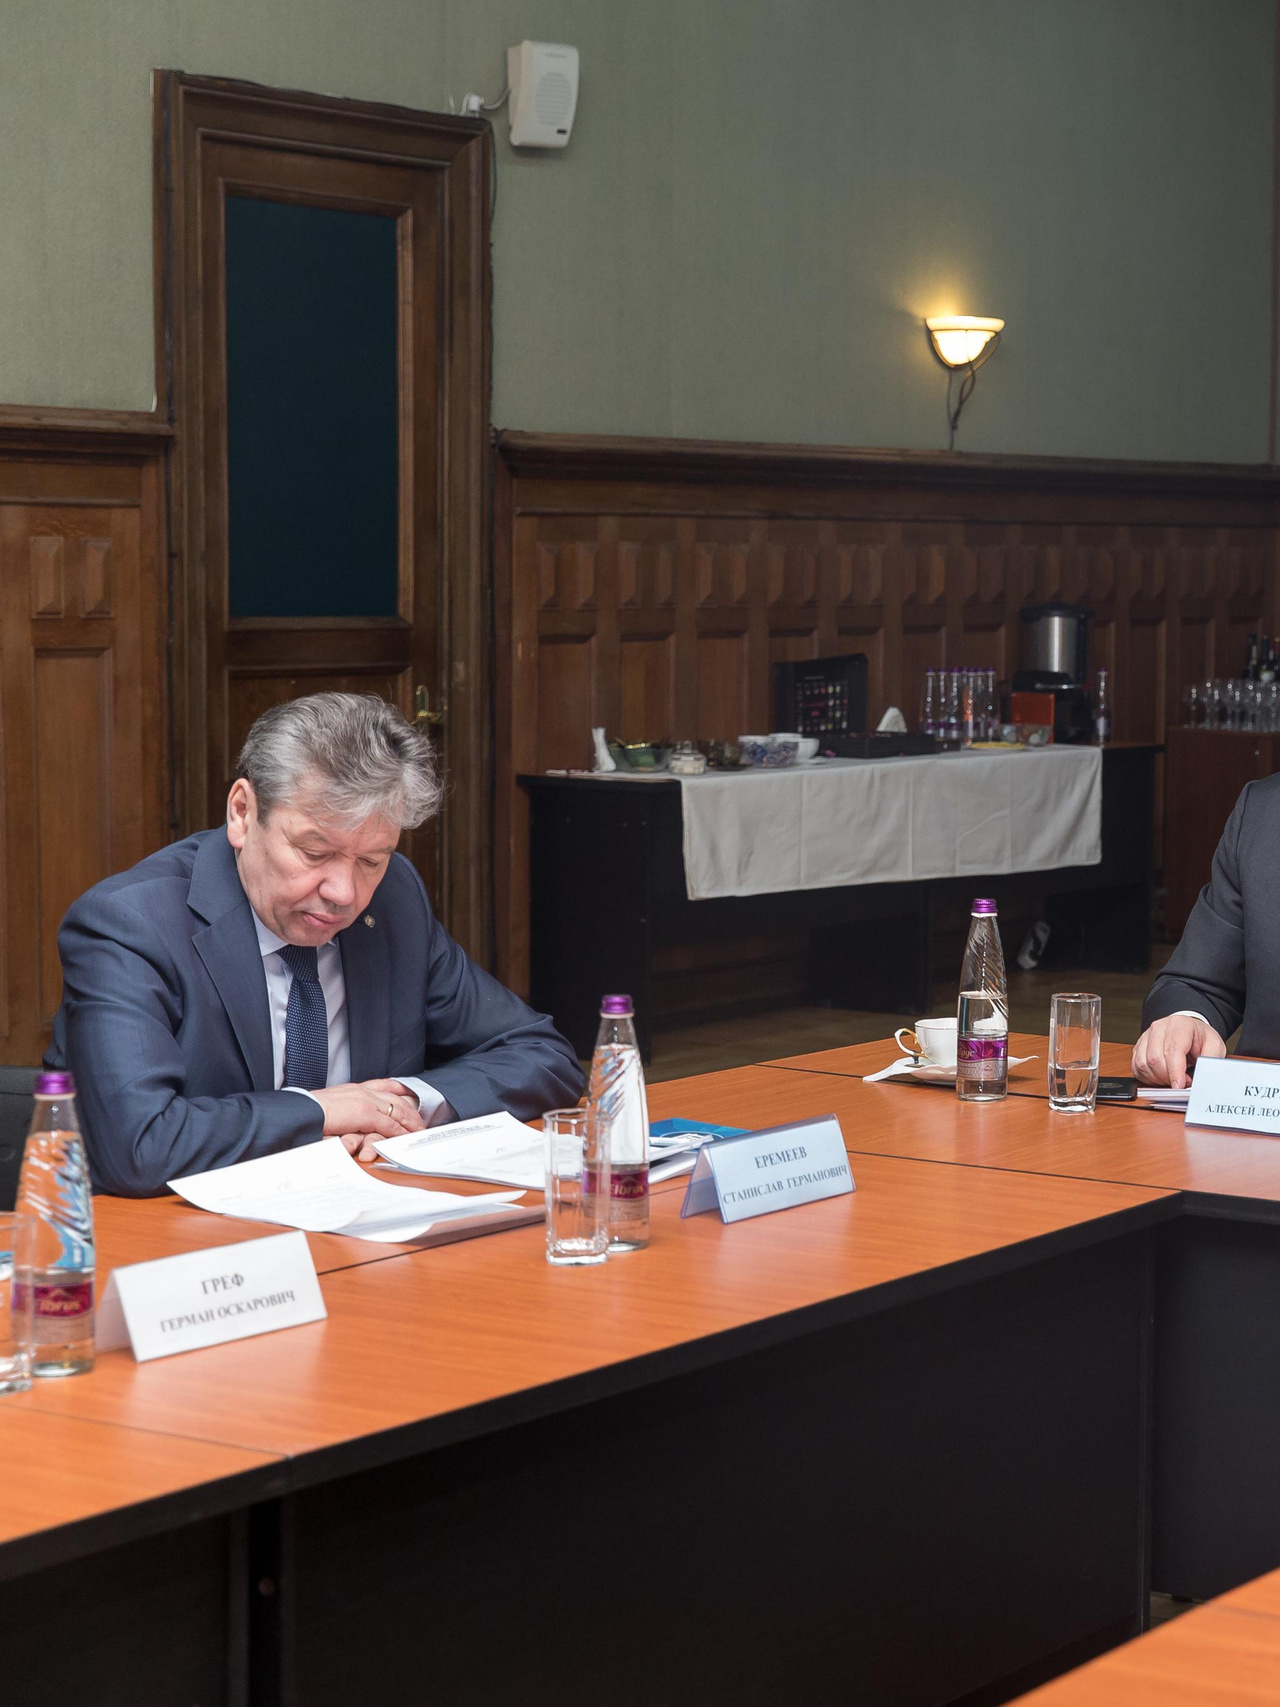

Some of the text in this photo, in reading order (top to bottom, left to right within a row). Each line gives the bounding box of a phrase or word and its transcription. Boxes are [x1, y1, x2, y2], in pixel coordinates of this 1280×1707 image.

[1205, 1104, 1256, 1117] АЛЕКСЕЙ
[754, 1146, 808, 1169] ЕРЕМЕЕВ
[723, 1164, 848, 1204] СТАНИСЛАВ ГЕРМАНОВИЧ
[201, 1273, 244, 1295] ГРЕФ
[160, 1290, 296, 1334] ГЕРМАН ОСКАРОВИЧ
